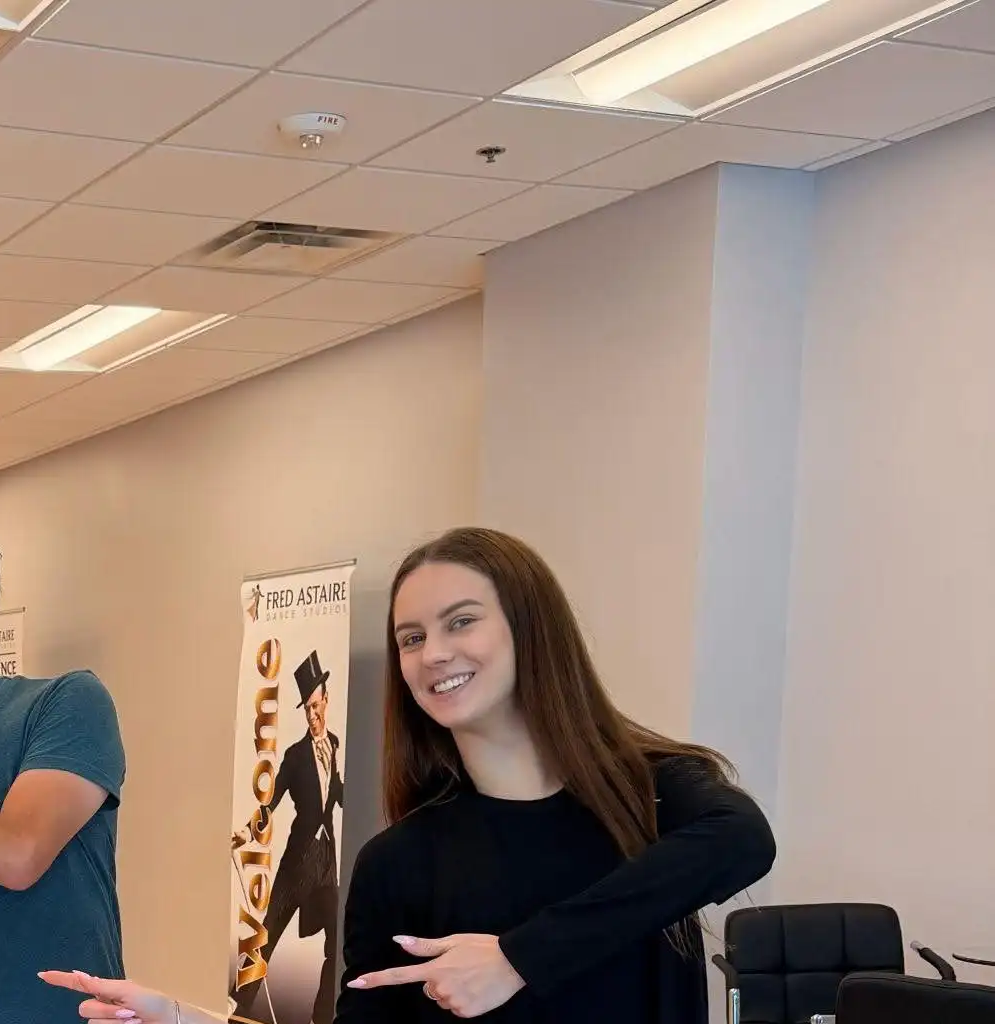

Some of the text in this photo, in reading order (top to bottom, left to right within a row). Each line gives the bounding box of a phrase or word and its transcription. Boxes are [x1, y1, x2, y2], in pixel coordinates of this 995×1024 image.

[317, 115, 339, 126] FIRE
[266, 581, 347, 610] FRED ASTAIRE
[236, 637, 282, 993] Welcome
